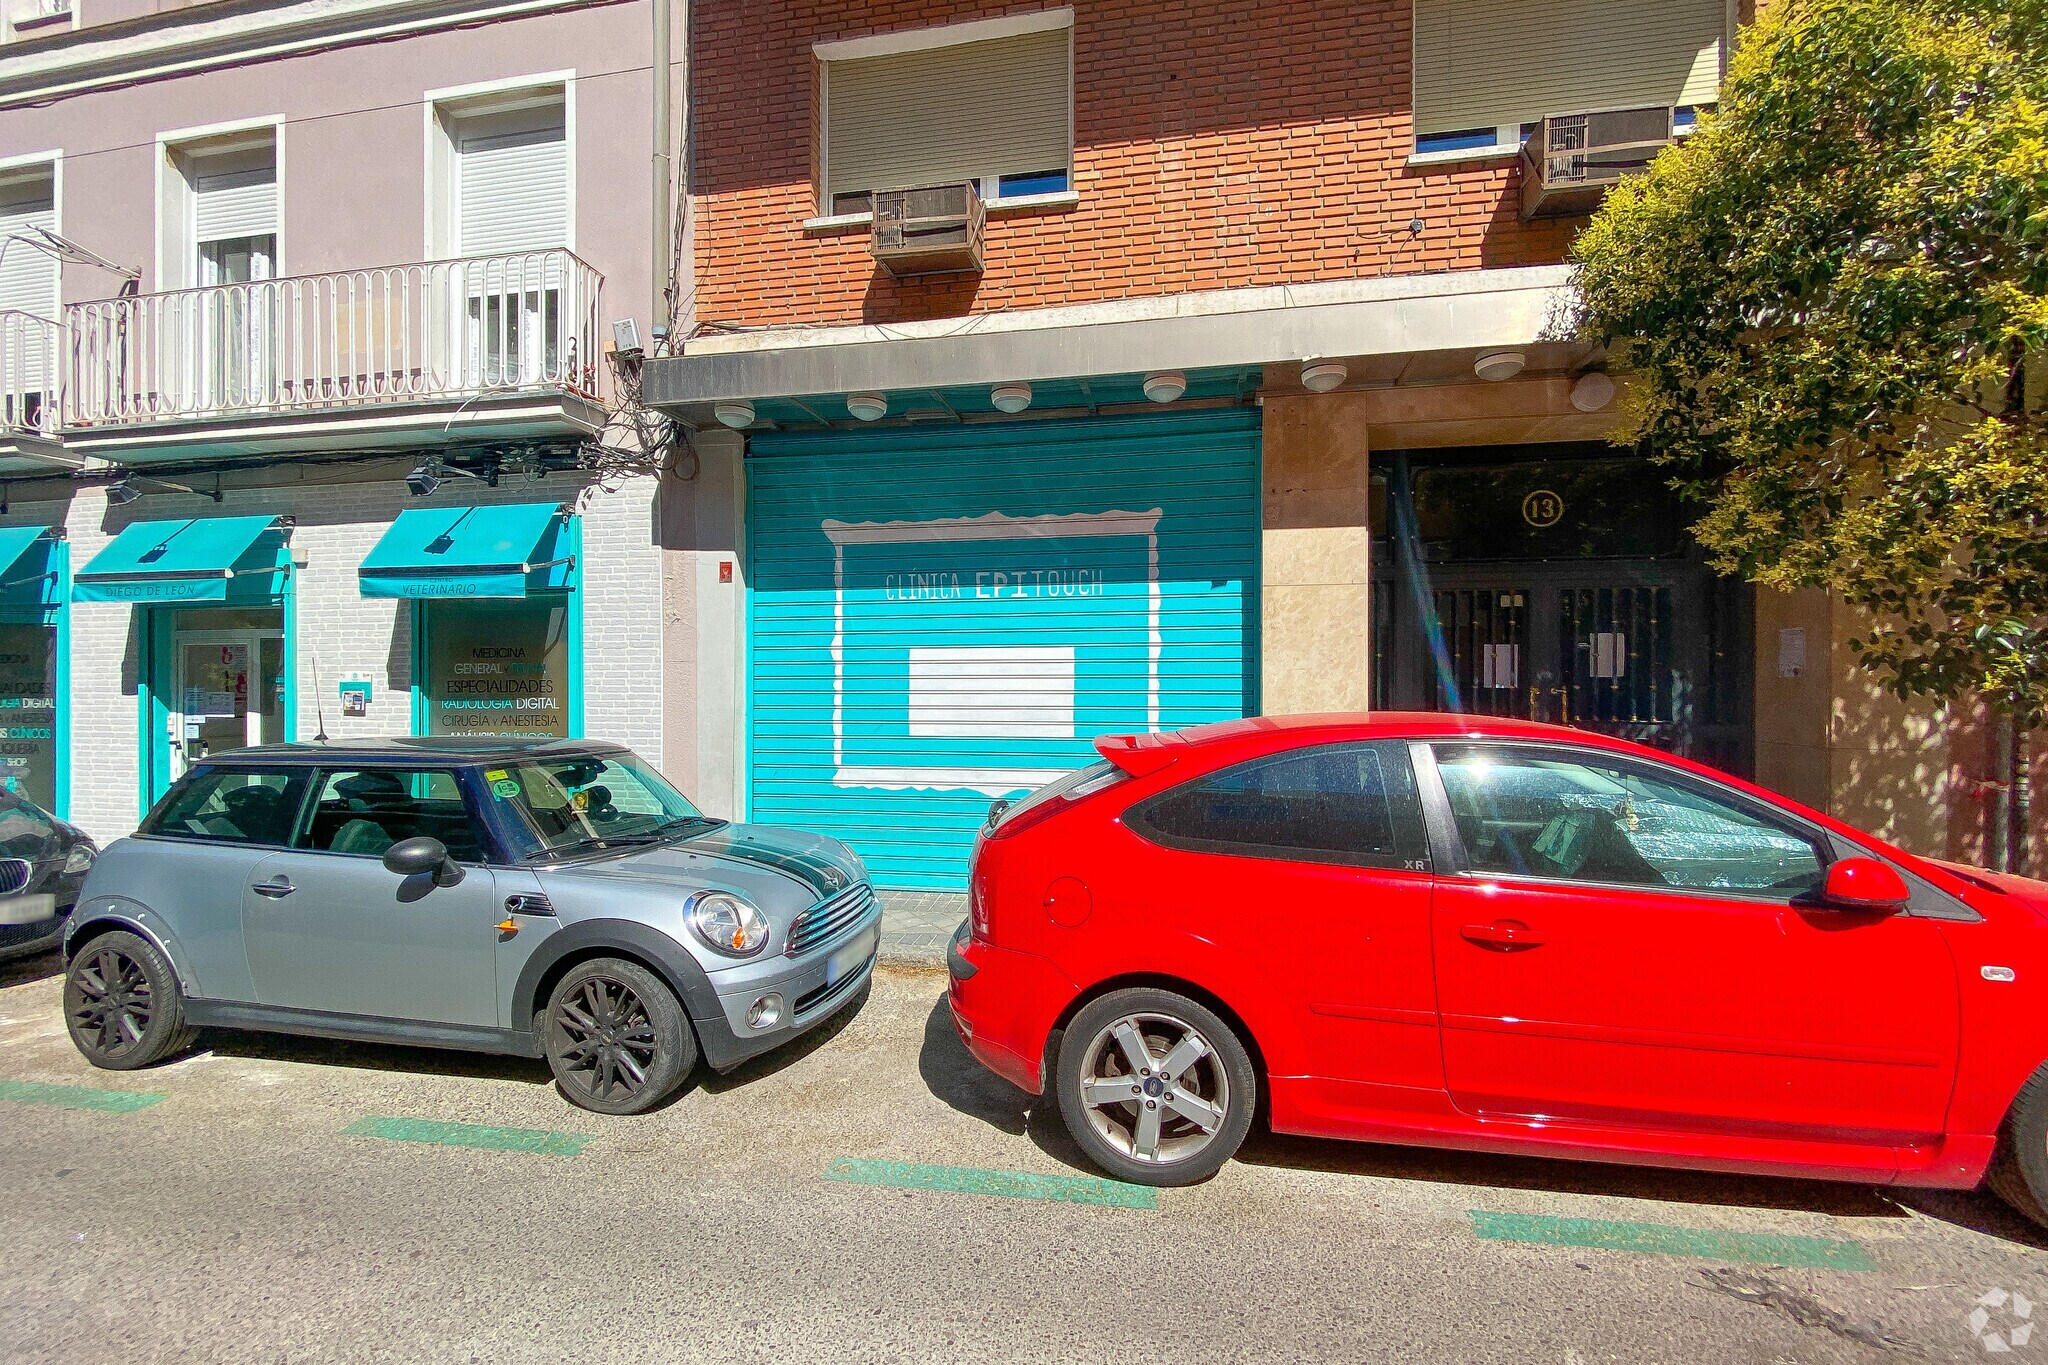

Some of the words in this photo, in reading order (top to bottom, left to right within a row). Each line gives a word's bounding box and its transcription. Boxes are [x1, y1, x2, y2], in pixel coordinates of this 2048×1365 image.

[1531, 499, 1554, 518] 13
[402, 583, 477, 595] VETERINARIO
[886, 567, 961, 600] CLÍNICA
[975, 569, 1103, 598] EPITOUCH
[105, 587, 142, 597] DIEGO
[147, 586, 161, 596] DE
[165, 584, 195, 596] LEÓN
[472, 647, 527, 659] MEDICINA
[454, 662, 504, 675] GENERAL
[447, 679, 554, 693] ESPECIALIDADES
[22, 697, 56, 709] DIGITAL
[516, 697, 560, 710] DIGITAL
[441, 712, 490, 727] CIRUGÍA
[500, 714, 559, 727] ANESTESIA
[7, 757, 28, 767] SHOP
[1404, 860, 1424, 870] XR
